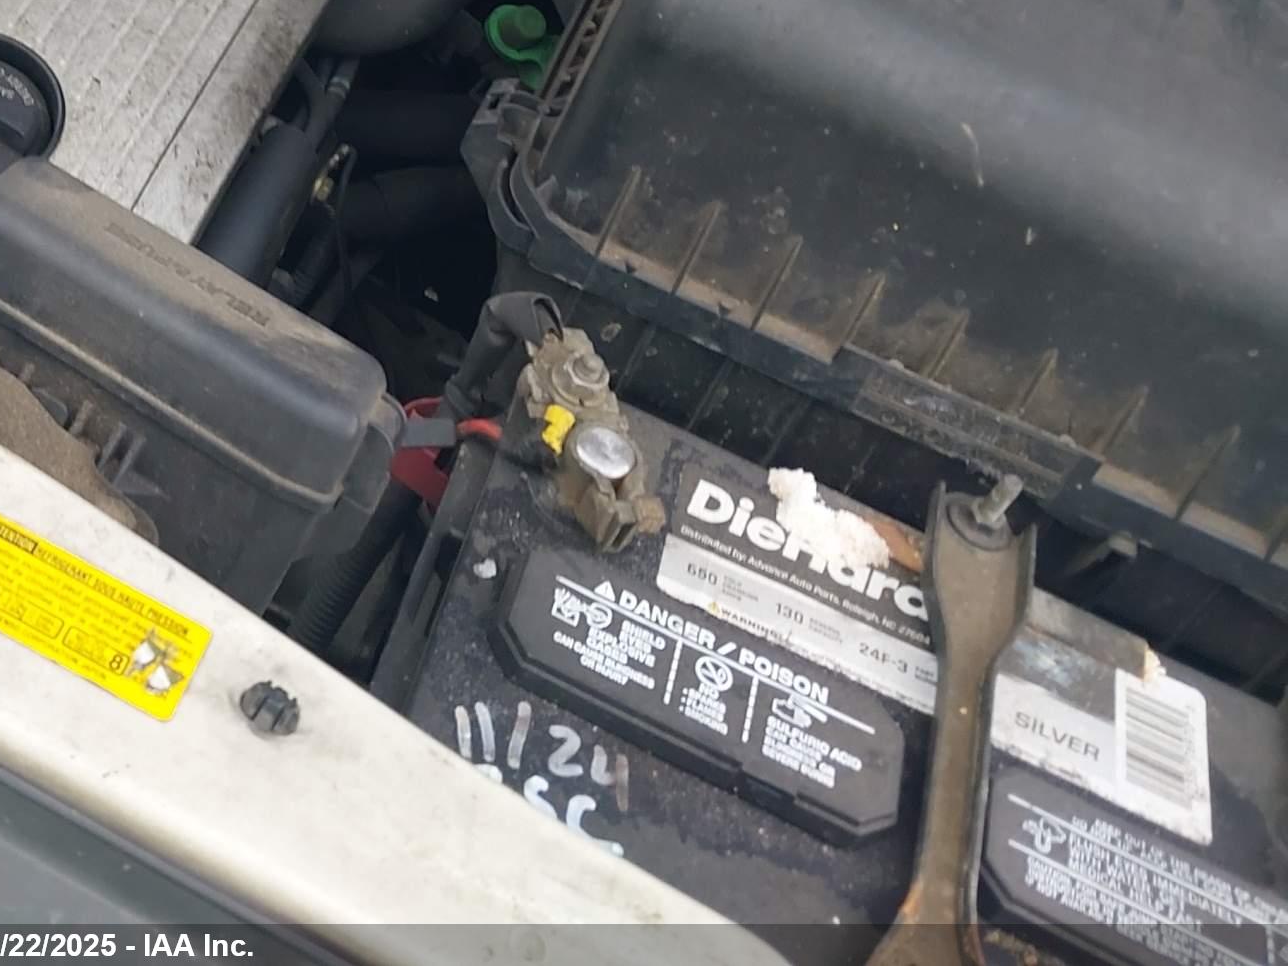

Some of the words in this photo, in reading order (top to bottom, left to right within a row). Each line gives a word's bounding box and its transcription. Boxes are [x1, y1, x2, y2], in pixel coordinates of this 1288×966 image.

[788, 572, 812, 591] Auto
[776, 601, 804, 624] 130
[587, 625, 656, 668] EXPLOSIVE
[619, 589, 716, 650] DANGER
[739, 647, 830, 704] POISON
[621, 620, 666, 651] SHIELD
[859, 641, 908, 673] 24F-3
[766, 714, 830, 756] SULFURIC
[829, 746, 863, 773] ACID
[1013, 710, 1101, 762] SILVER
